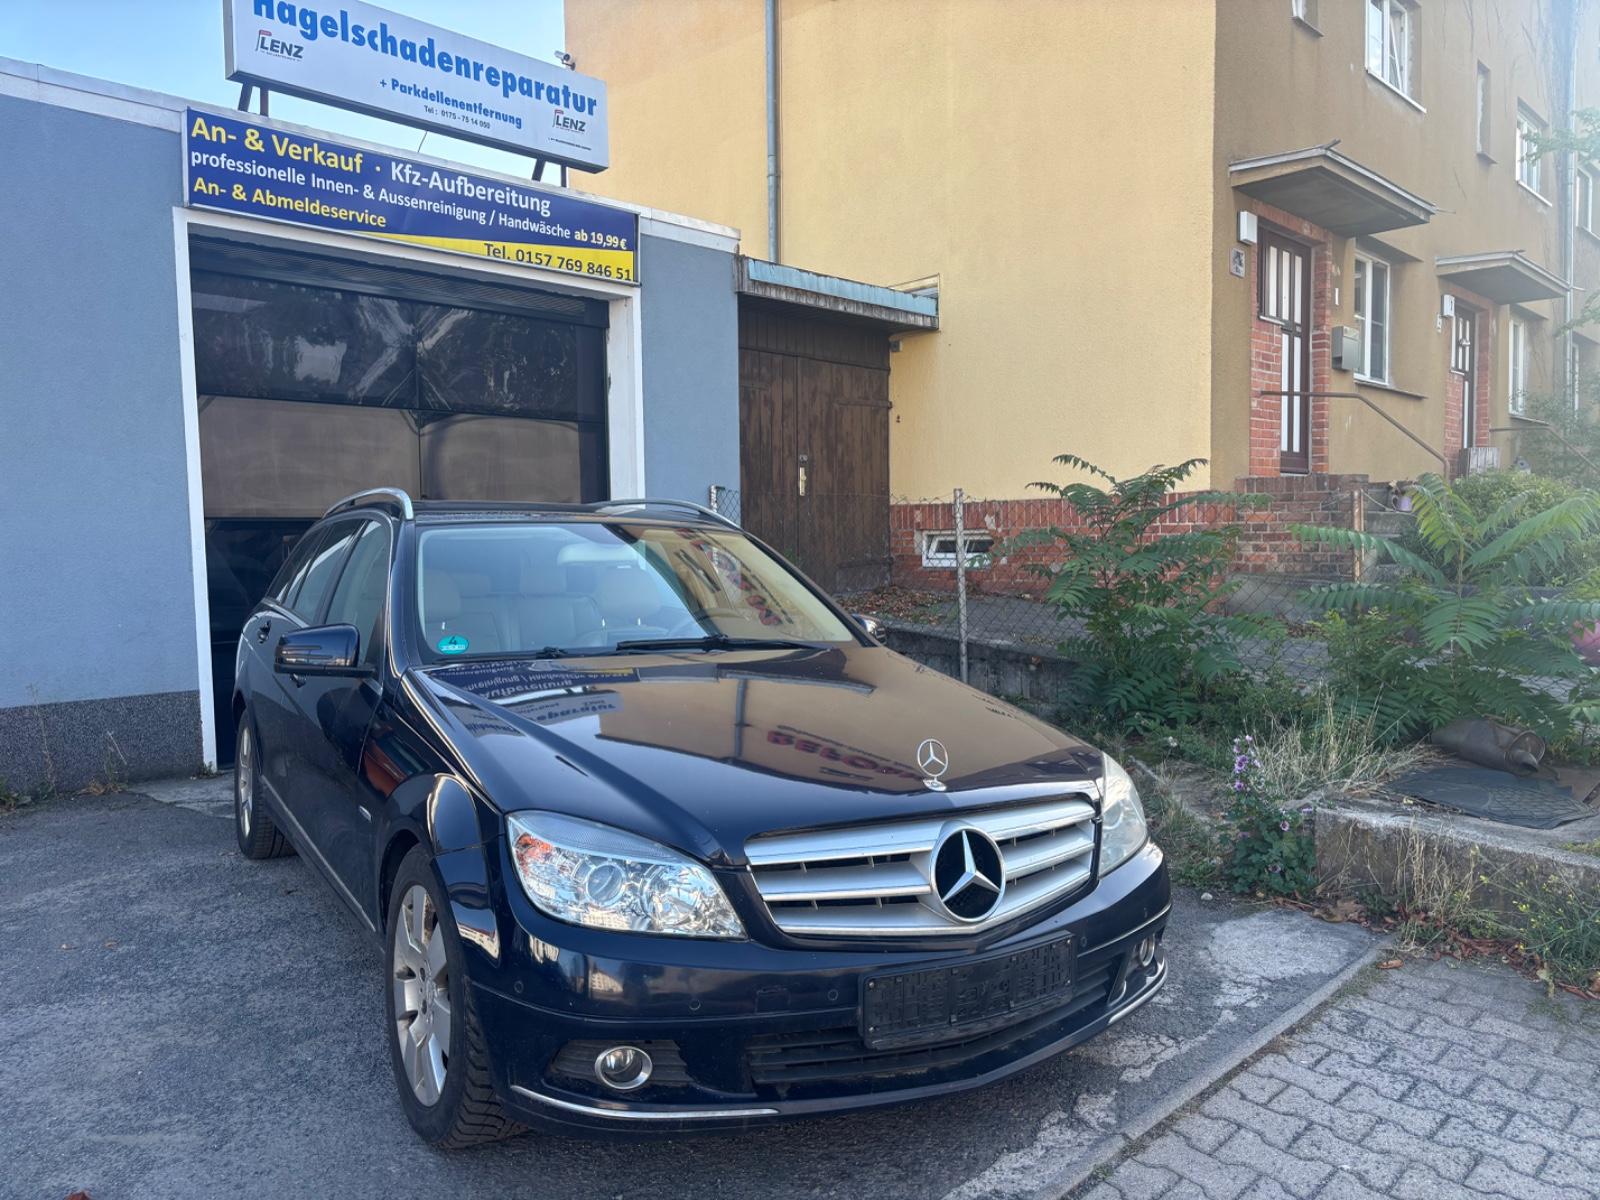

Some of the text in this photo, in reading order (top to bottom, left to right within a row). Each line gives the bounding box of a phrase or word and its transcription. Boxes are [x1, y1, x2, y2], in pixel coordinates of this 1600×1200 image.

[253, 0, 597, 116] Hagelschadenreparatur
[260, 36, 304, 59] LENZ
[391, 78, 522, 129] Parkdellenentfernung
[441, 110, 457, 120] 0175
[556, 115, 586, 131] LENZ
[191, 117, 551, 217] An- & Verkauf Kfz-Aufbereitung
[191, 151, 305, 185] professionelle
[311, 173, 359, 196] Innen-
[363, 184, 375, 200] &
[378, 188, 486, 225] Aussenreinigung
[489, 210, 496, 226] /
[499, 213, 571, 239] Handwäsche
[574, 230, 588, 243] ab
[194, 177, 387, 227] An- & Abmeldeservice
[484, 243, 631, 281] Tel. 0157 769 846 51
[449, 636, 457, 645] 4
